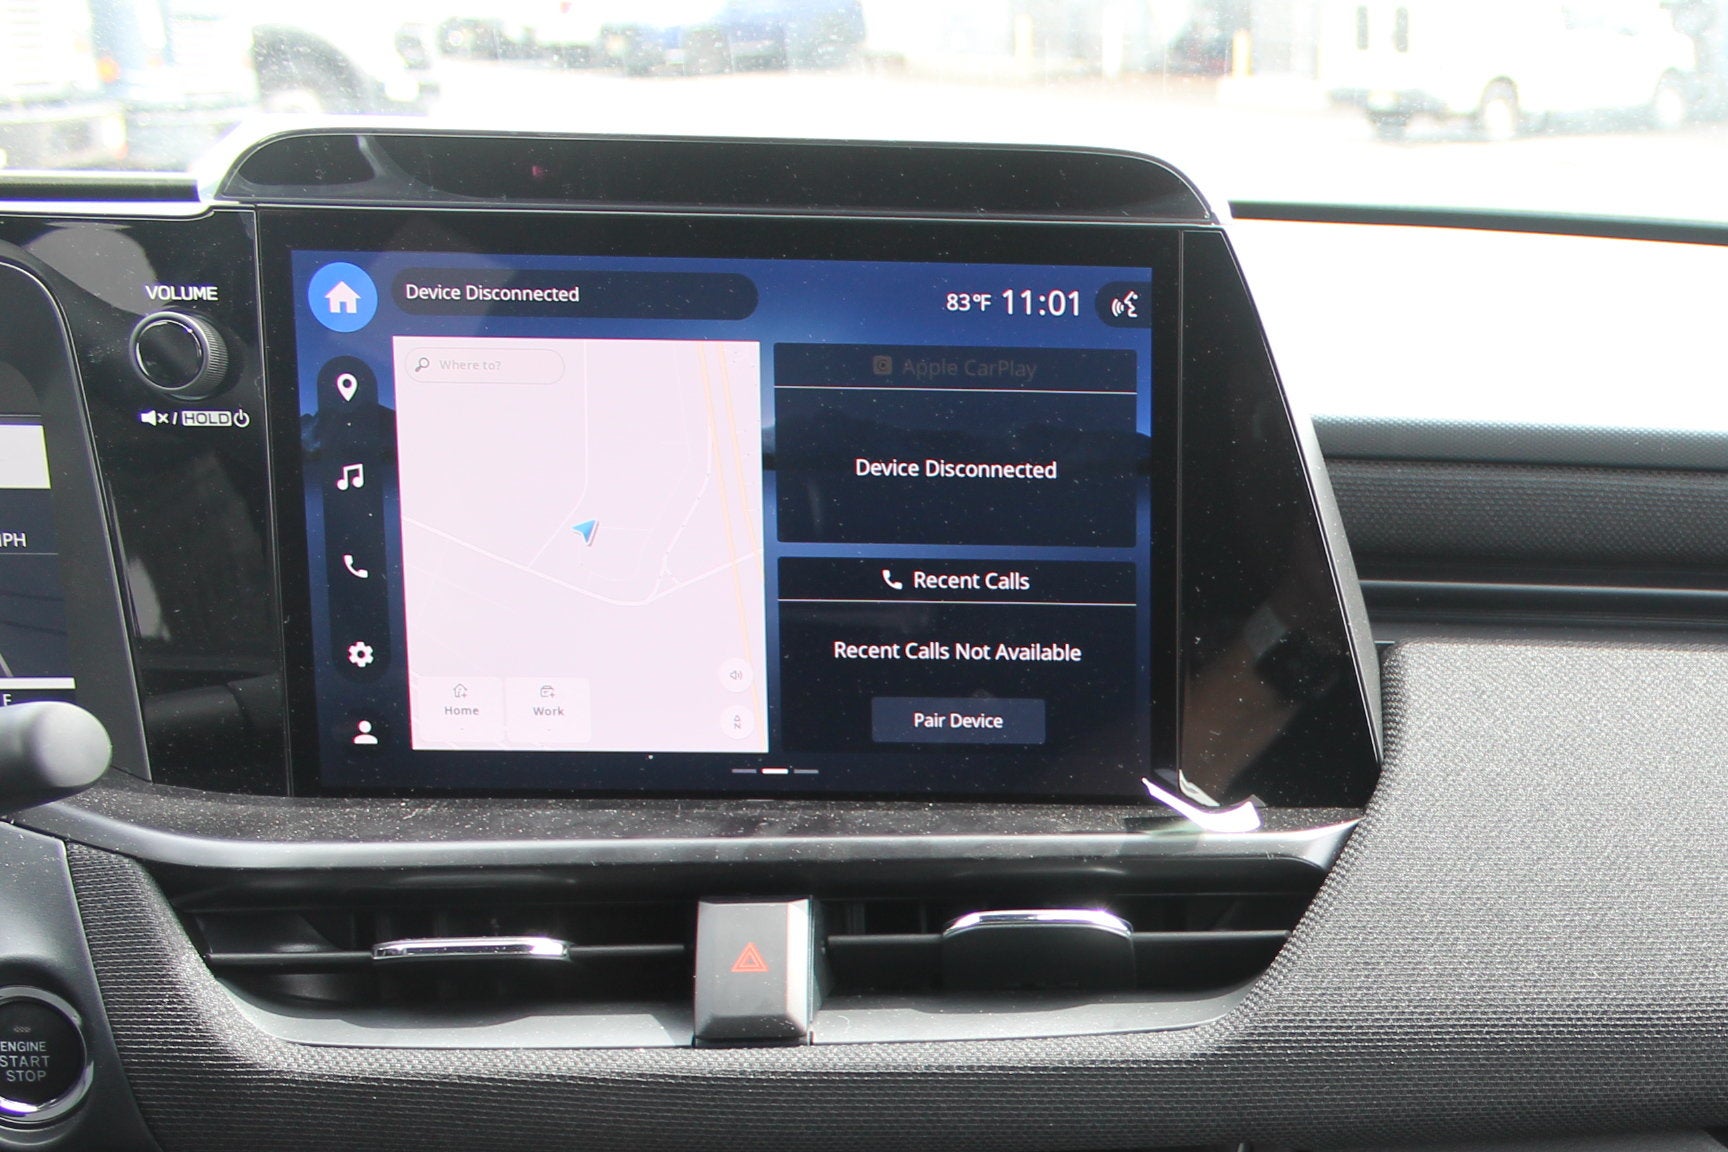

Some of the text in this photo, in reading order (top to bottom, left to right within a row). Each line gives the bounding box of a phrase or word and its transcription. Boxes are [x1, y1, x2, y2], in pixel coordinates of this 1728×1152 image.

[145, 285, 218, 301] VOLUME
[406, 284, 580, 302] Device Disconnected
[946, 293, 991, 311] 83°F
[1002, 289, 1080, 316] 11:01
[440, 360, 502, 370] Where to?
[902, 359, 1037, 382] Apple CarPlay
[184, 412, 230, 425] HOLD
[856, 458, 1058, 479] Device Disconnected
[914, 571, 1030, 590] Recent Calls
[833, 641, 1082, 662] Recent Calls Not Available
[444, 706, 480, 716] Home
[533, 706, 565, 716] Work
[914, 712, 1004, 729] Pair Device
[0, 1041, 47, 1052] ENGINE
[0, 1055, 50, 1068] START
[6, 1070, 47, 1082] STOP
